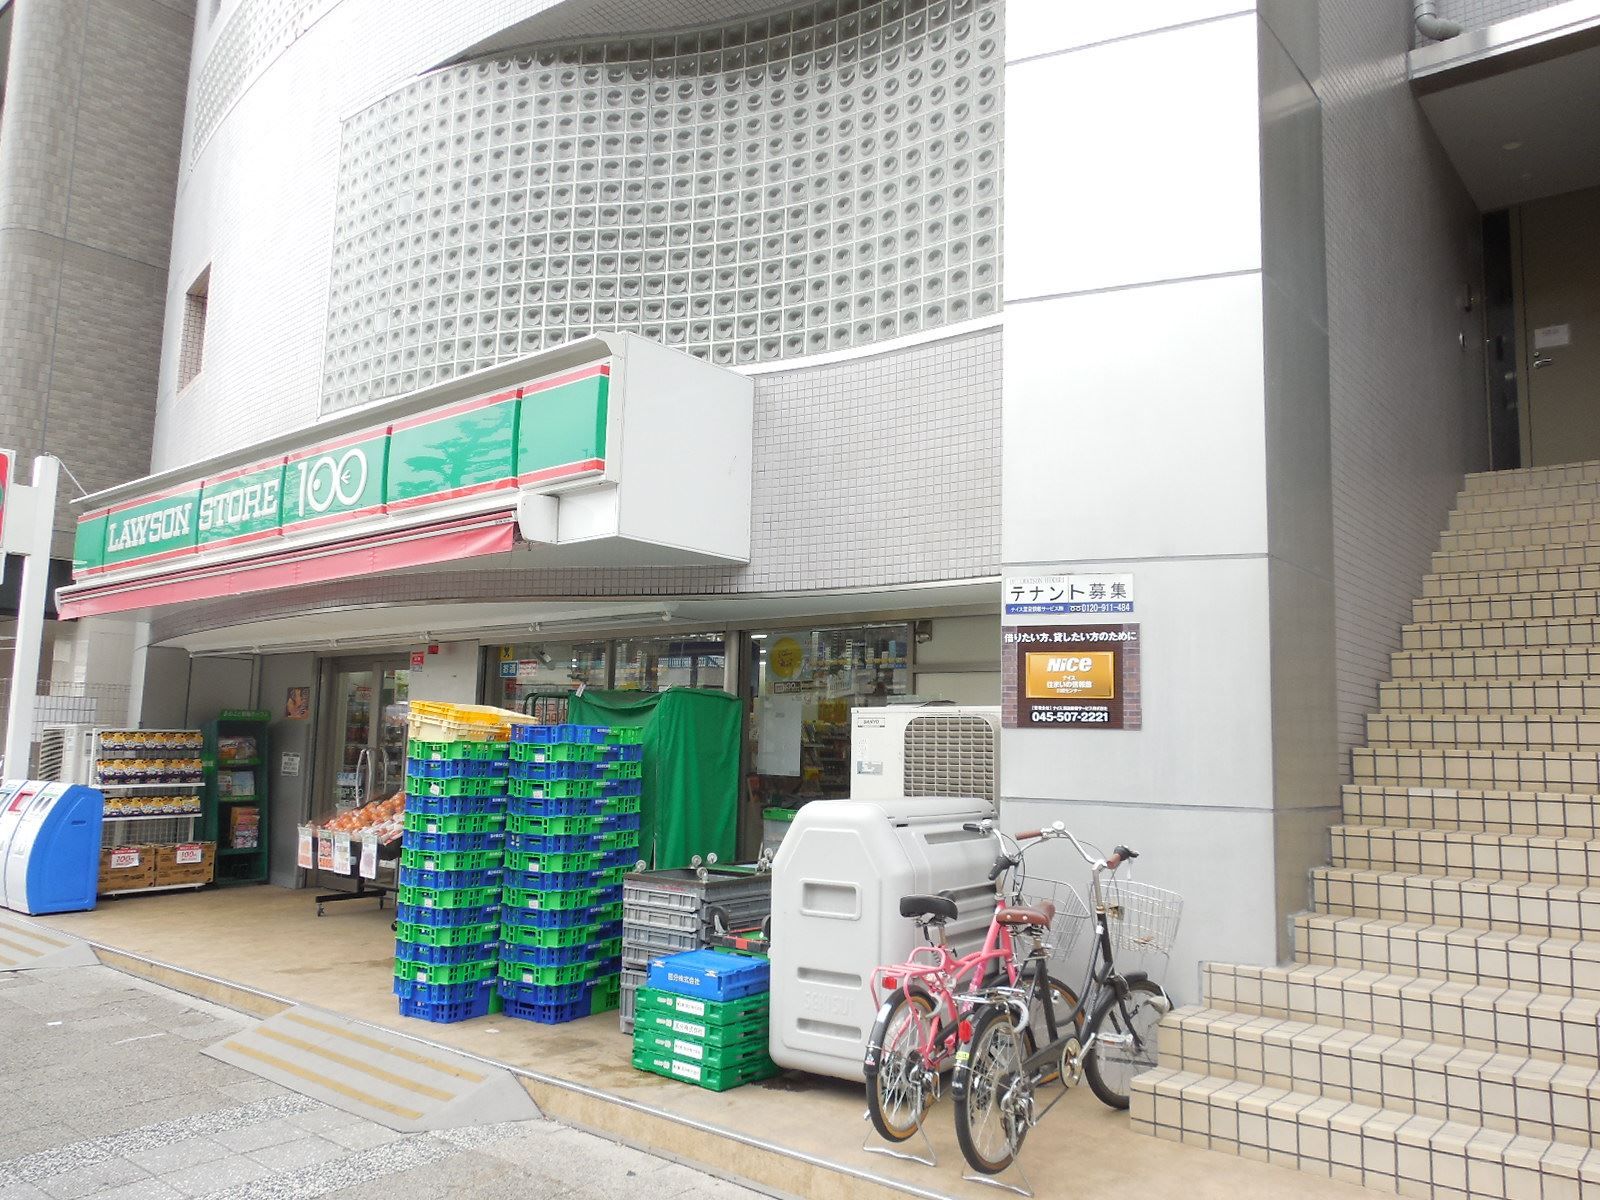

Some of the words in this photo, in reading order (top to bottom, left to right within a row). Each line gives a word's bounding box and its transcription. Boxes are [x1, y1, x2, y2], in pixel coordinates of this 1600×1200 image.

[107, 503, 193, 552] LAWSON
[198, 480, 280, 531] STORE
[298, 448, 368, 517] 100
[1010, 581, 1127, 602] テナント募集
[1081, 603, 1131, 613] 0120-911-484
[1004, 631, 1137, 643] 借りたい方、貸したい方のために
[1031, 712, 1109, 722] 045-507-2221
